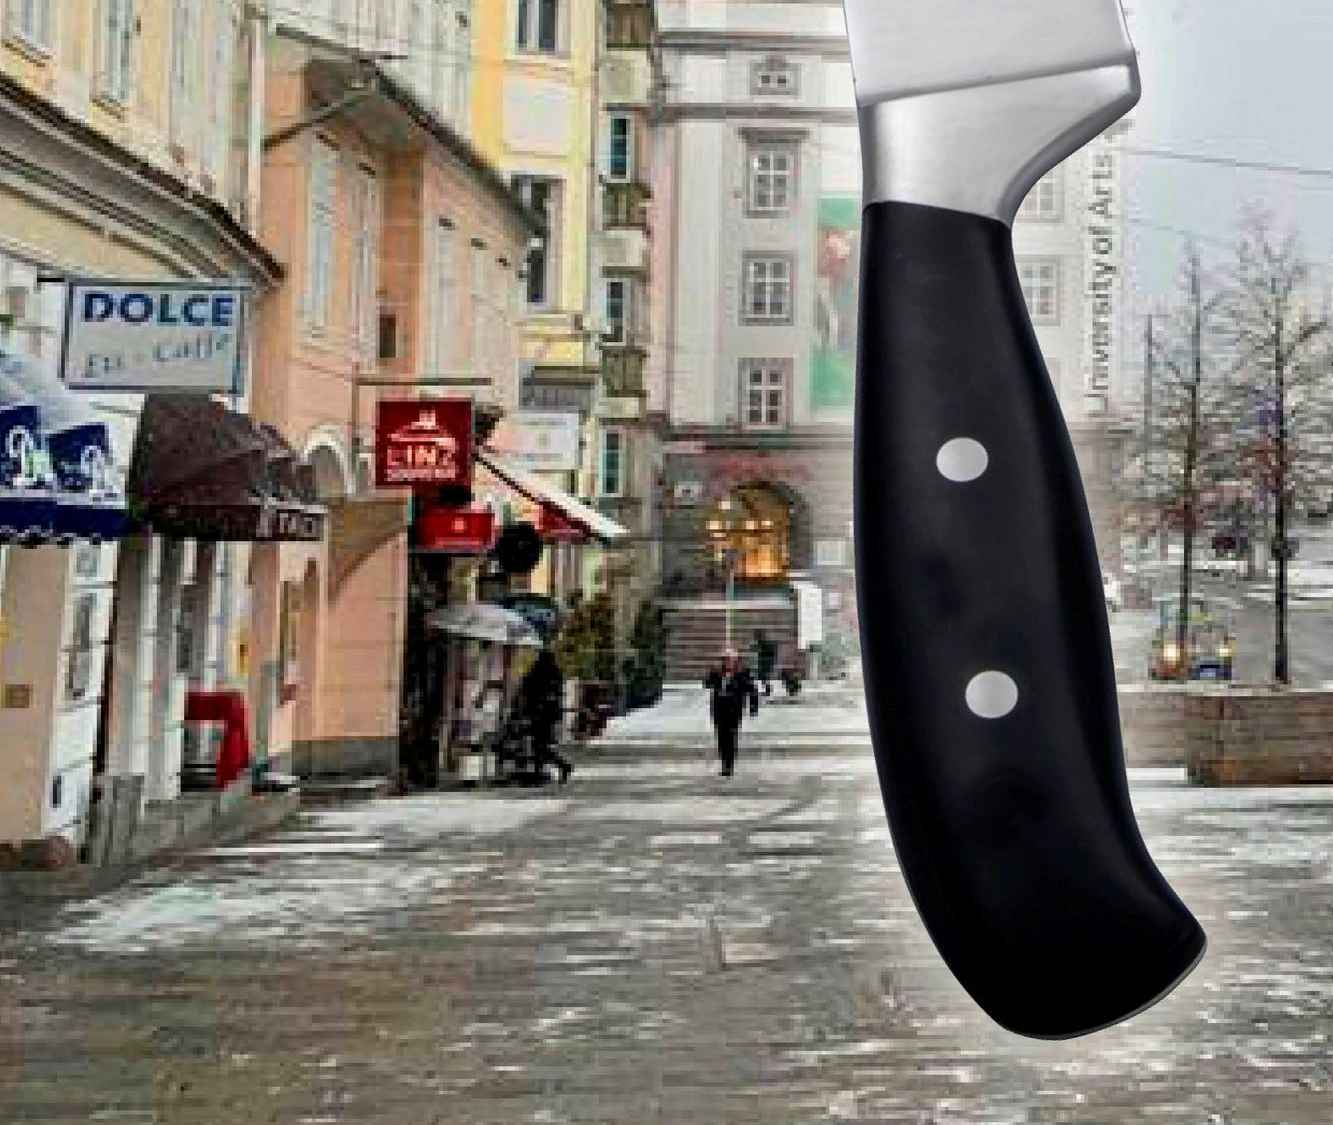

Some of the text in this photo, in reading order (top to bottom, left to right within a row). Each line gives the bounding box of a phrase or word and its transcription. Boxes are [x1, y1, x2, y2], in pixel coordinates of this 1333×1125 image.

[1087, 153, 1114, 220] Arts
[1087, 225, 1113, 257] of
[83, 292, 234, 327] DOLCE
[386, 443, 457, 469] LINZ
